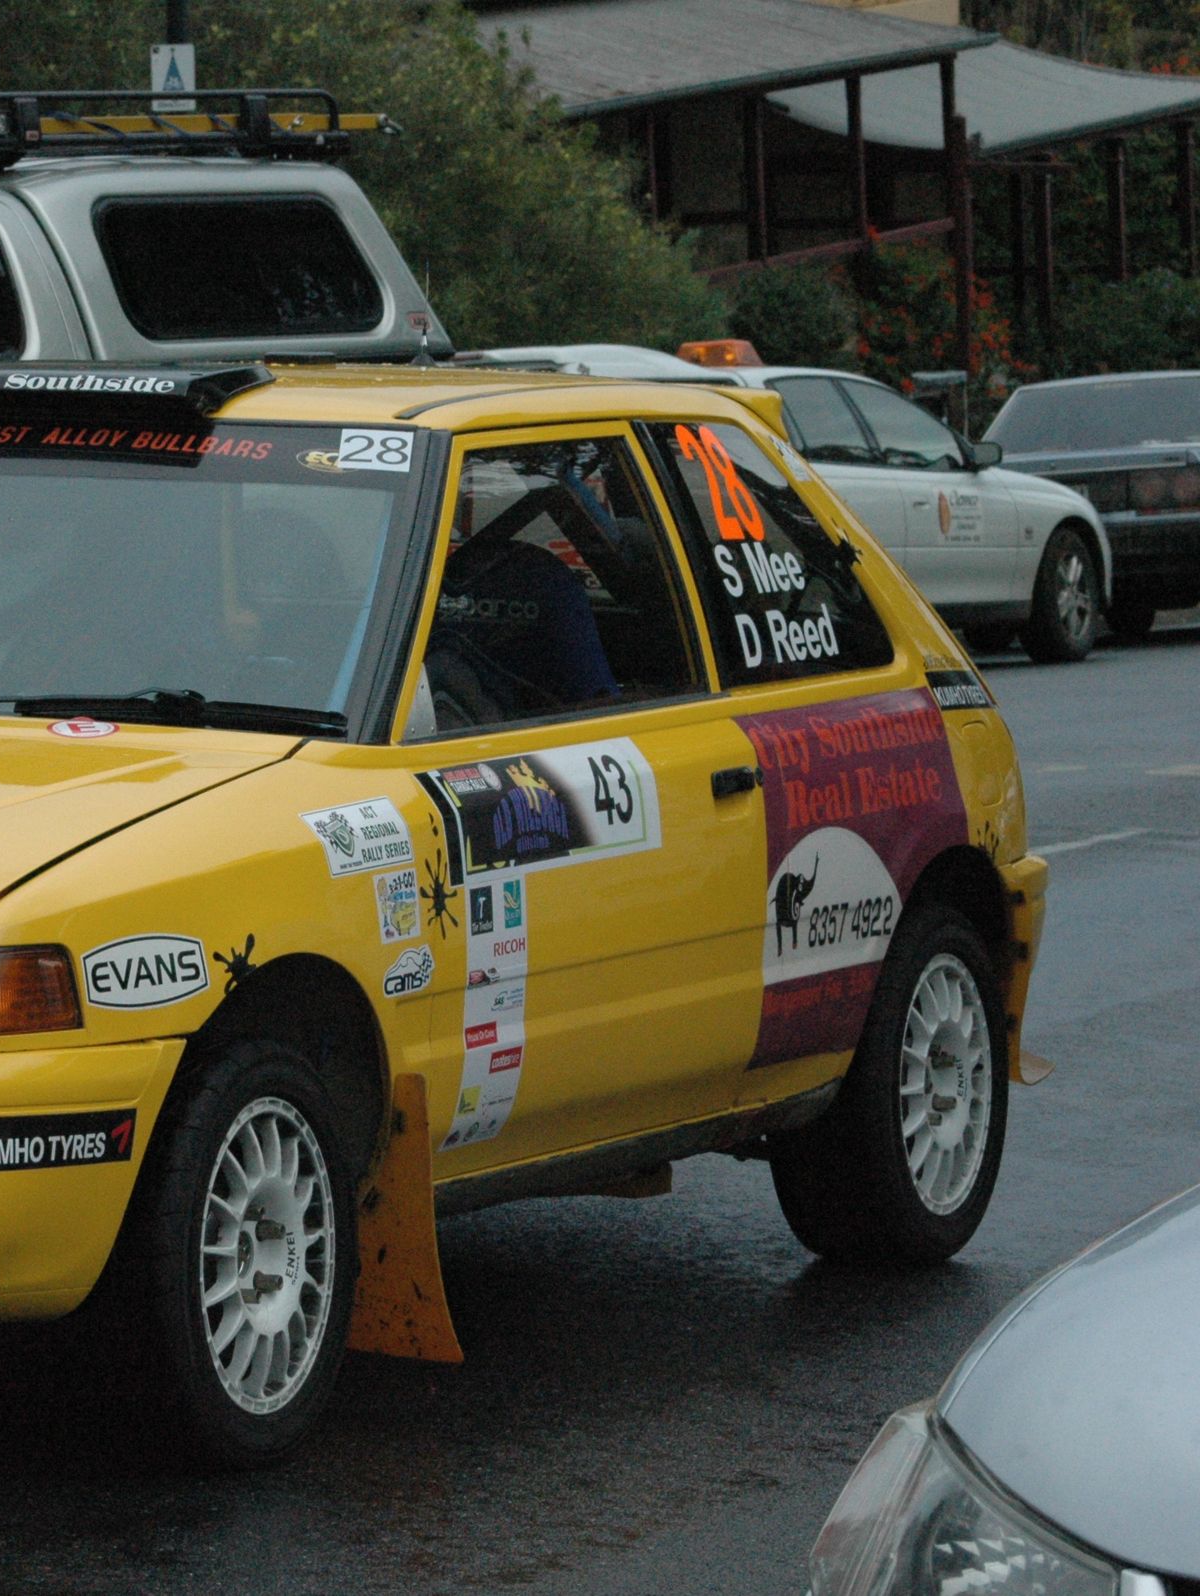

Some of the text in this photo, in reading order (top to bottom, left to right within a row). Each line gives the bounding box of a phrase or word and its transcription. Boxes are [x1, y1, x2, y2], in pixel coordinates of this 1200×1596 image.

[3, 373, 175, 394] Southside
[41, 427, 126, 449] ALLOY
[132, 431, 274, 461] BULLBARS
[339, 435, 410, 466] 28
[674, 424, 765, 542] 28
[714, 542, 806, 598] S Mee
[735, 603, 840, 669] D Reed
[751, 705, 947, 773] City Southside
[587, 754, 635, 826] 43
[784, 758, 942, 830] Real Estate
[359, 805, 379, 820] ACT
[360, 821, 401, 841] REGIONAL
[361, 840, 411, 864] RALLY SERIES
[807, 895, 894, 948] 8357 4922
[493, 938, 526, 957] RICOH
[91, 949, 201, 993] EVANS
[48, 1131, 108, 1162] TYRES
[285, 1231, 296, 1279] ENKEI
